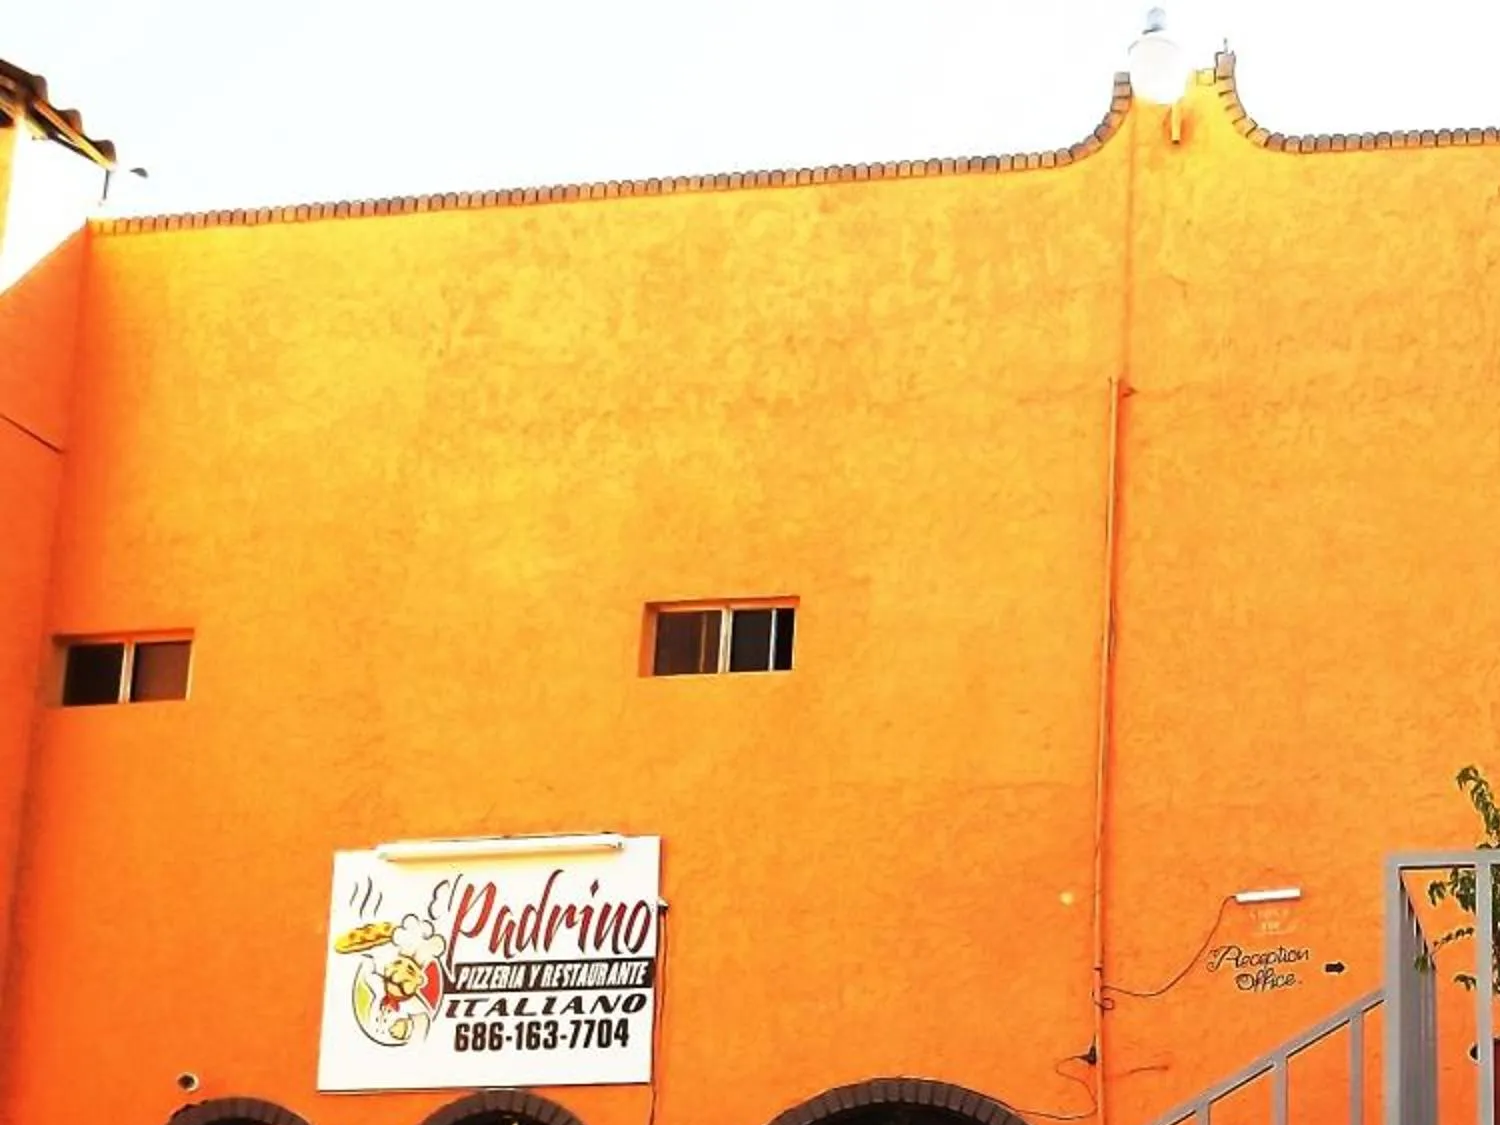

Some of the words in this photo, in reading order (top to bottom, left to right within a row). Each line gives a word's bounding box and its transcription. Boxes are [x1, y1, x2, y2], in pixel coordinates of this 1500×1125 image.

[446, 868, 651, 974] Padrino
[1206, 945, 1309, 972] Reception
[456, 964, 526, 991] PIZZERIA
[528, 963, 544, 989] Y
[540, 961, 650, 988] RESTAURANTE
[1235, 965, 1297, 992] Office
[445, 993, 648, 1019] ITALIANO
[454, 1018, 630, 1052] 686-163-7704
